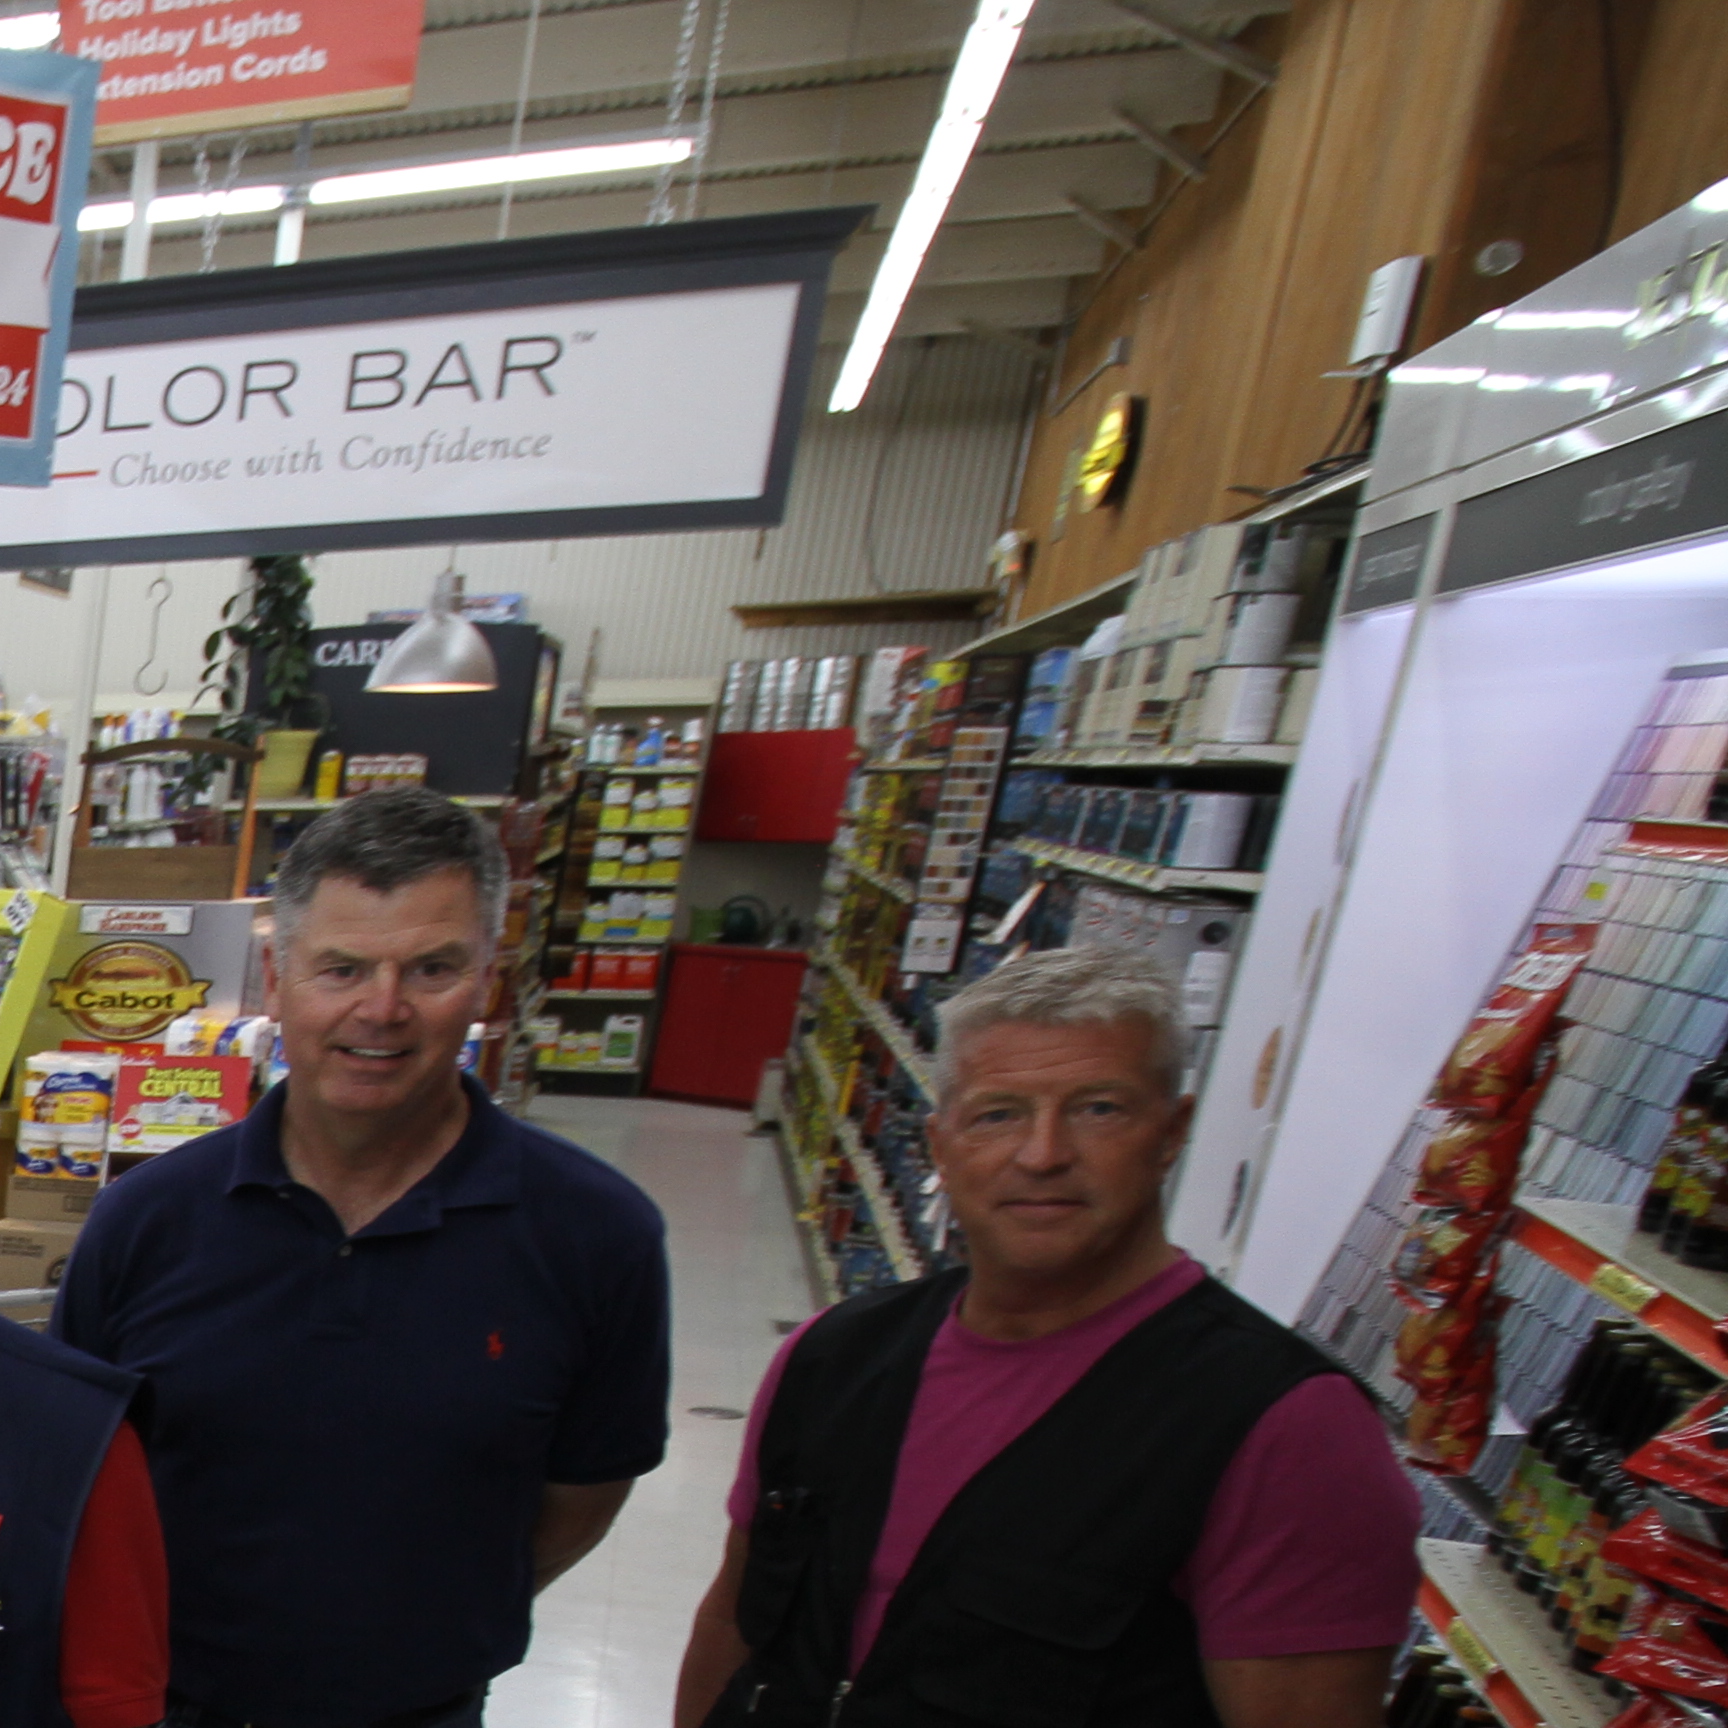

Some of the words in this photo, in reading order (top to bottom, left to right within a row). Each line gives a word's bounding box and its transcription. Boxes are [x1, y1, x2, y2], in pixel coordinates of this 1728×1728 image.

[77, 28, 195, 62] Holiday
[201, 9, 303, 49] Lights
[96, 62, 224, 99] tension
[230, 46, 327, 82] Cords
[55, 358, 299, 438] OLOR
[344, 334, 564, 412] BAR
[110, 451, 232, 488] Choose
[247, 438, 322, 476] with
[339, 427, 552, 480] Confidence
[314, 639, 392, 667] CAR
[75, 990, 176, 1009] Cabot
[139, 1079, 224, 1098] CENTRAL
